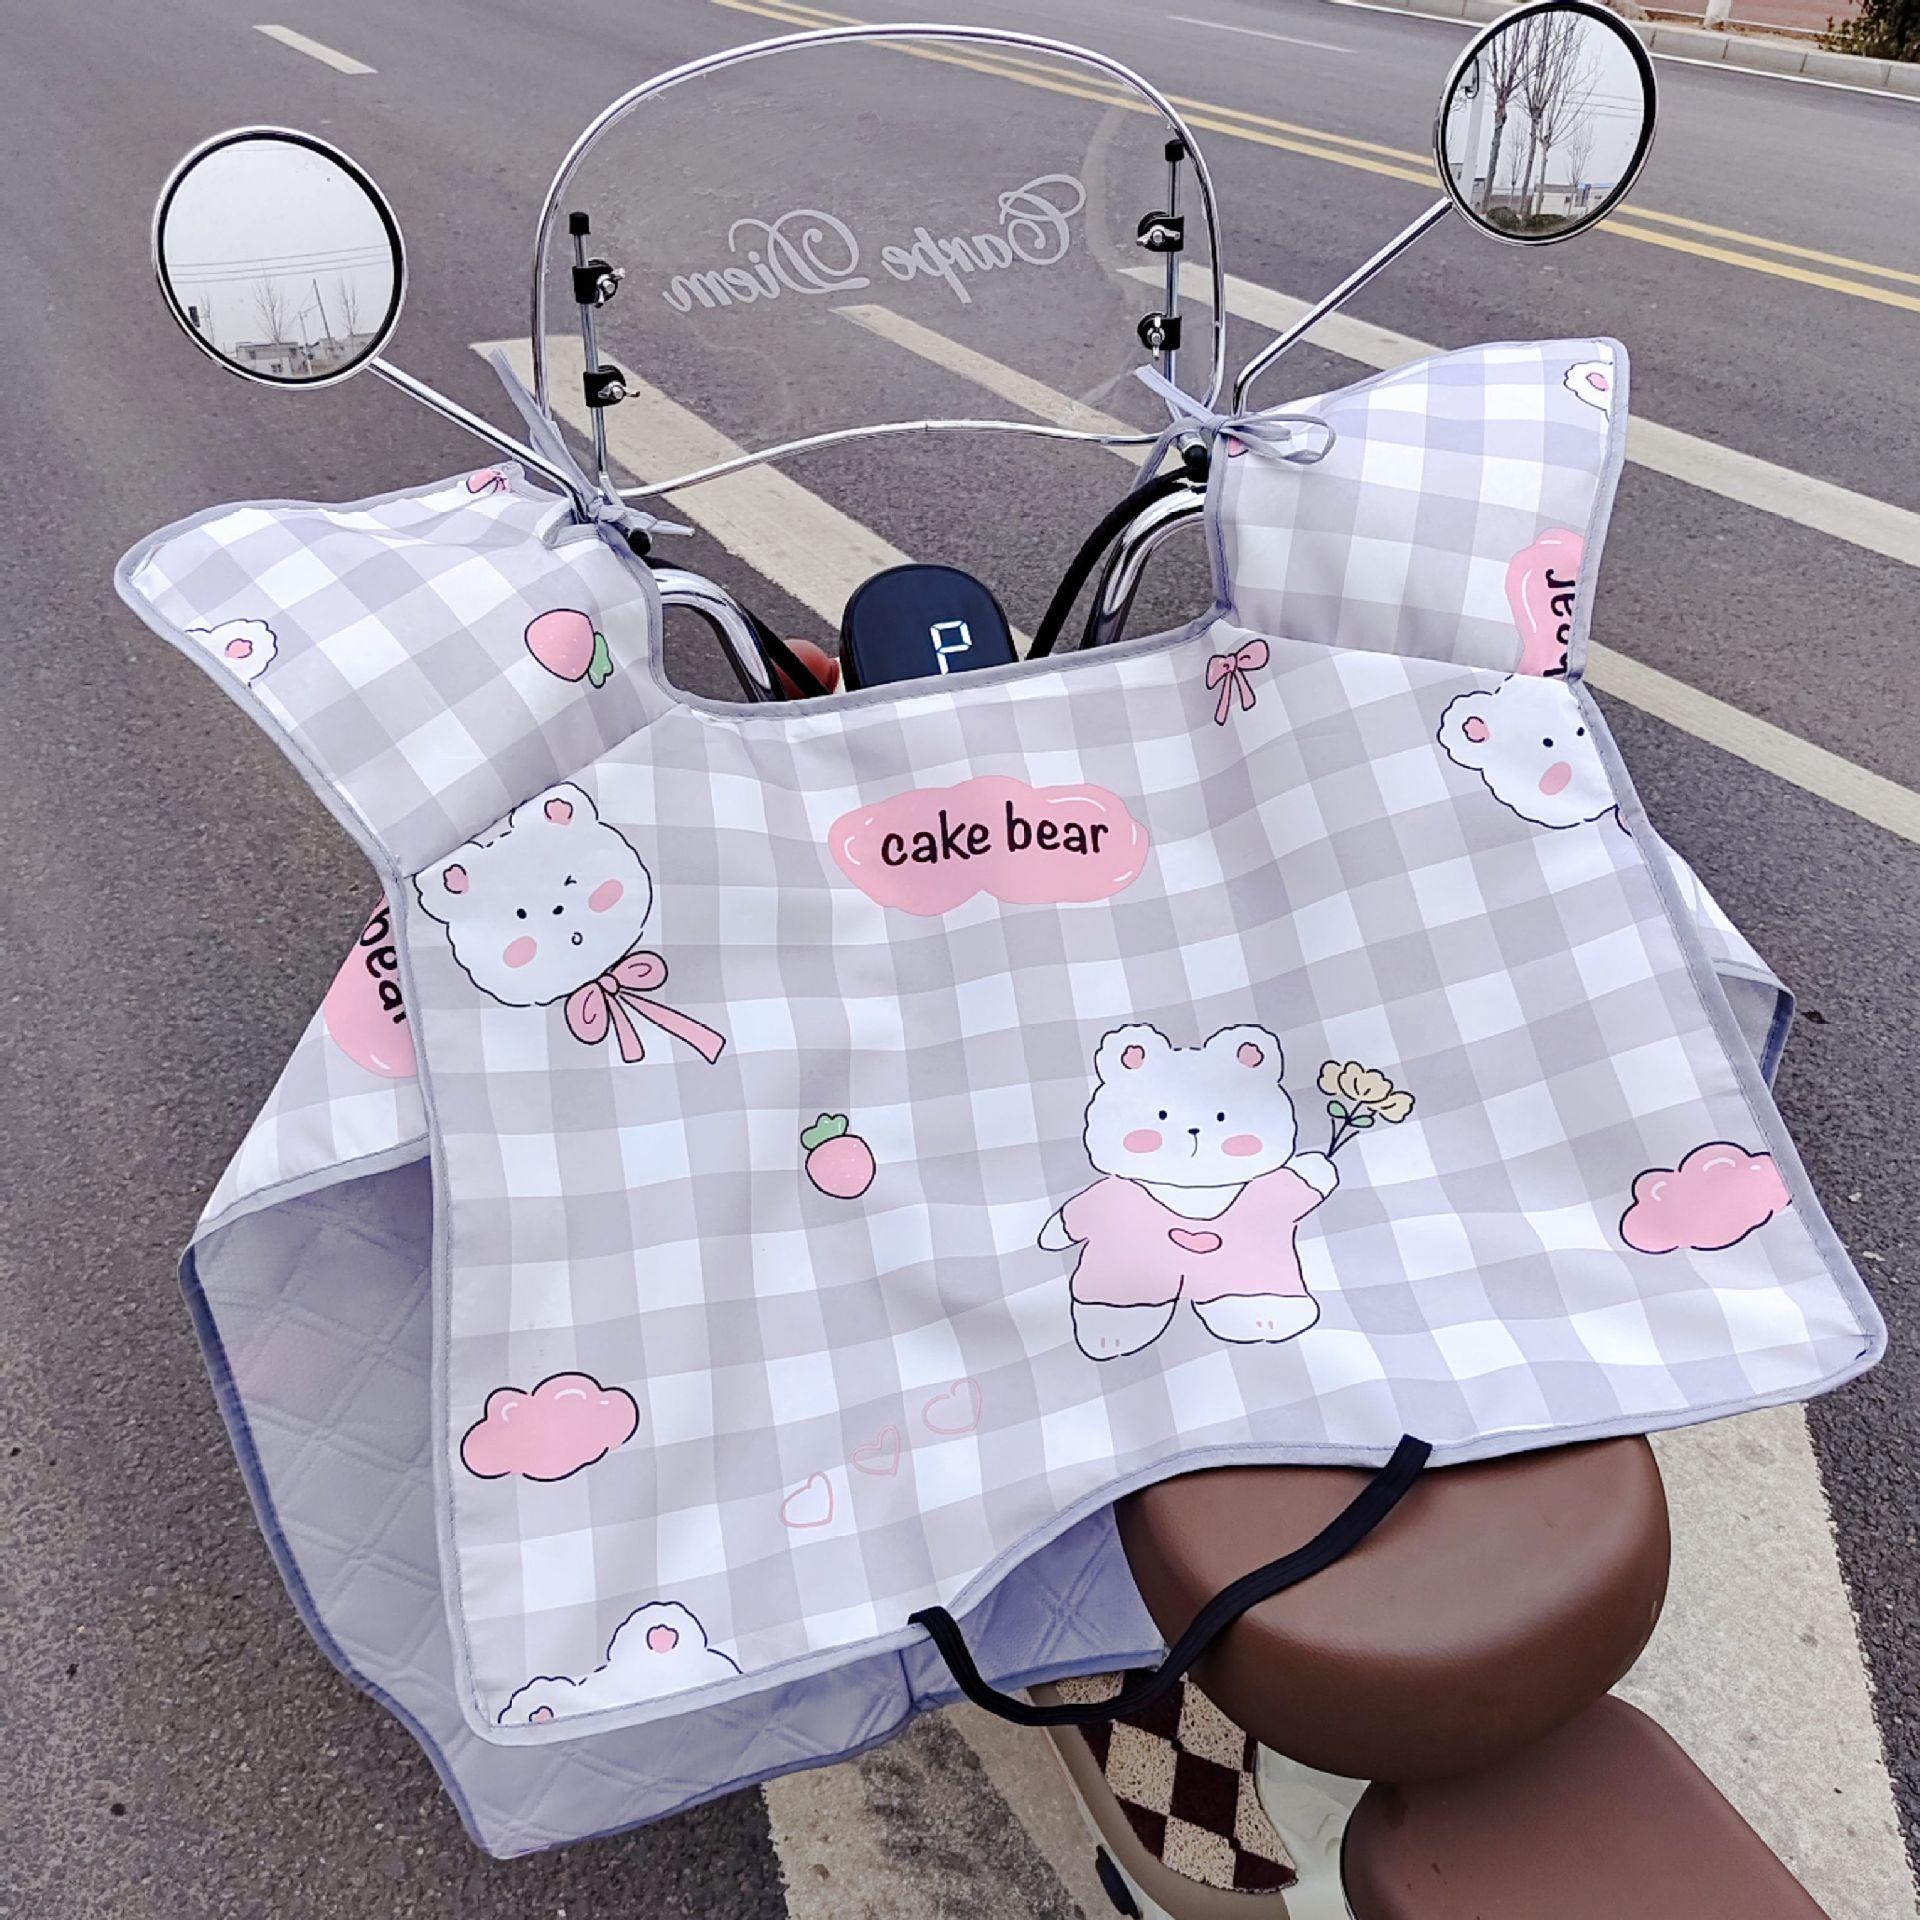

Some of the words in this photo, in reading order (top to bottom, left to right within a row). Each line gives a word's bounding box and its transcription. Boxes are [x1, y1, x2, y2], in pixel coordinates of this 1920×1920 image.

[930, 620, 973, 676] P
[881, 809, 992, 866] cake
[1005, 800, 1109, 855] bear
